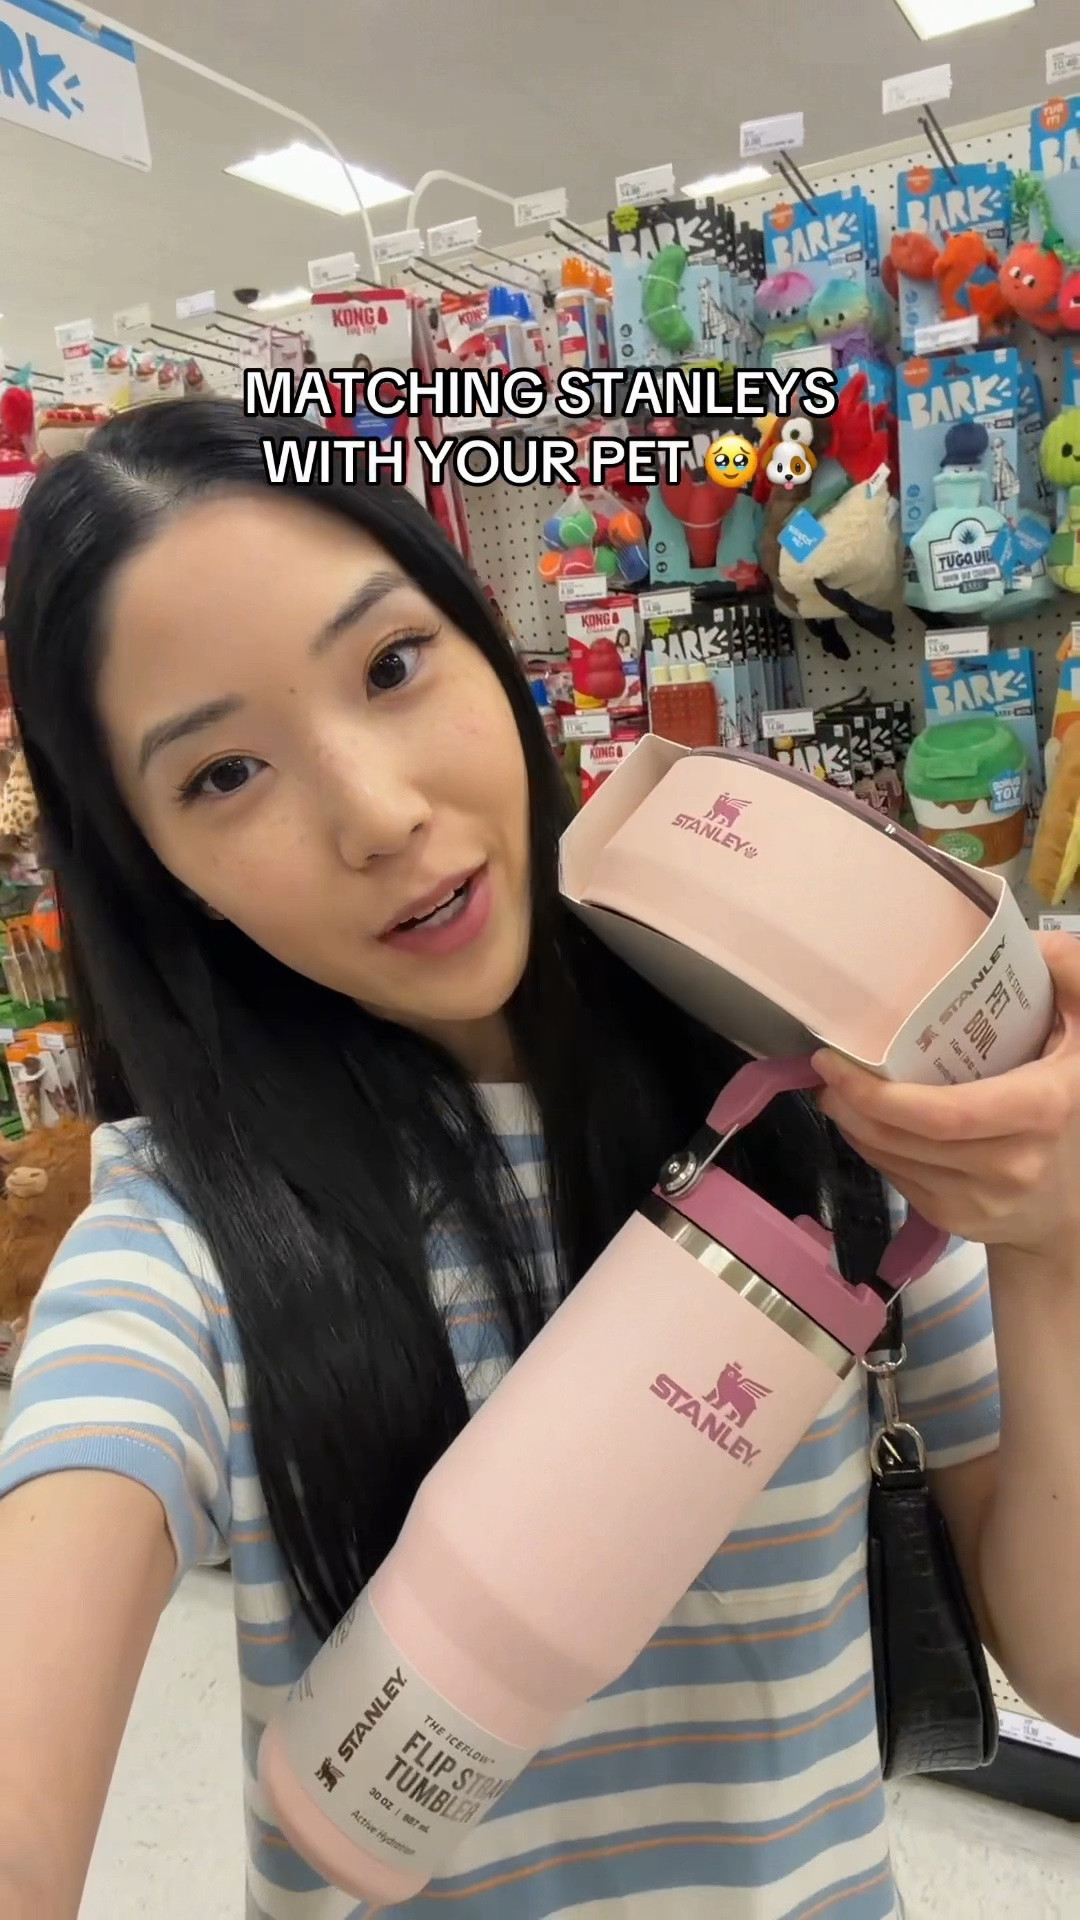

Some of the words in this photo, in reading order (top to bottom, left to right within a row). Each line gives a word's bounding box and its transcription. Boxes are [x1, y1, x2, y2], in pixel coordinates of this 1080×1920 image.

[907, 186, 995, 235] BARK
[617, 216, 704, 267] BARK
[772, 211, 852, 269] BARK
[332, 307, 376, 327] KONG
[907, 374, 1002, 430] BARK
[939, 549, 994, 570] TUGQUIL
[581, 612, 611, 628] KONG
[651, 625, 722, 664] BARK
[931, 669, 1020, 716] BARK
[590, 746, 616, 761] KONG
[994, 786, 1020, 801] TOY
[671, 813, 749, 852] STANLEY
[938, 934, 1006, 1025] STANLEY
[1004, 963, 1017, 983] THE
[984, 979, 1011, 1020] PET
[962, 1007, 998, 1061] BOWL
[648, 1373, 762, 1466] STANLEY
[337, 1666, 405, 1763] STANLEY
[424, 1714, 446, 1736] THE
[401, 1729, 457, 1778] FLIP
[451, 1767, 510, 1800] STRA
[368, 1786, 382, 1801] 30
[380, 1797, 394, 1811] OZ
[385, 1753, 482, 1824] TUMBLER
[350, 1809, 377, 1833] Active
